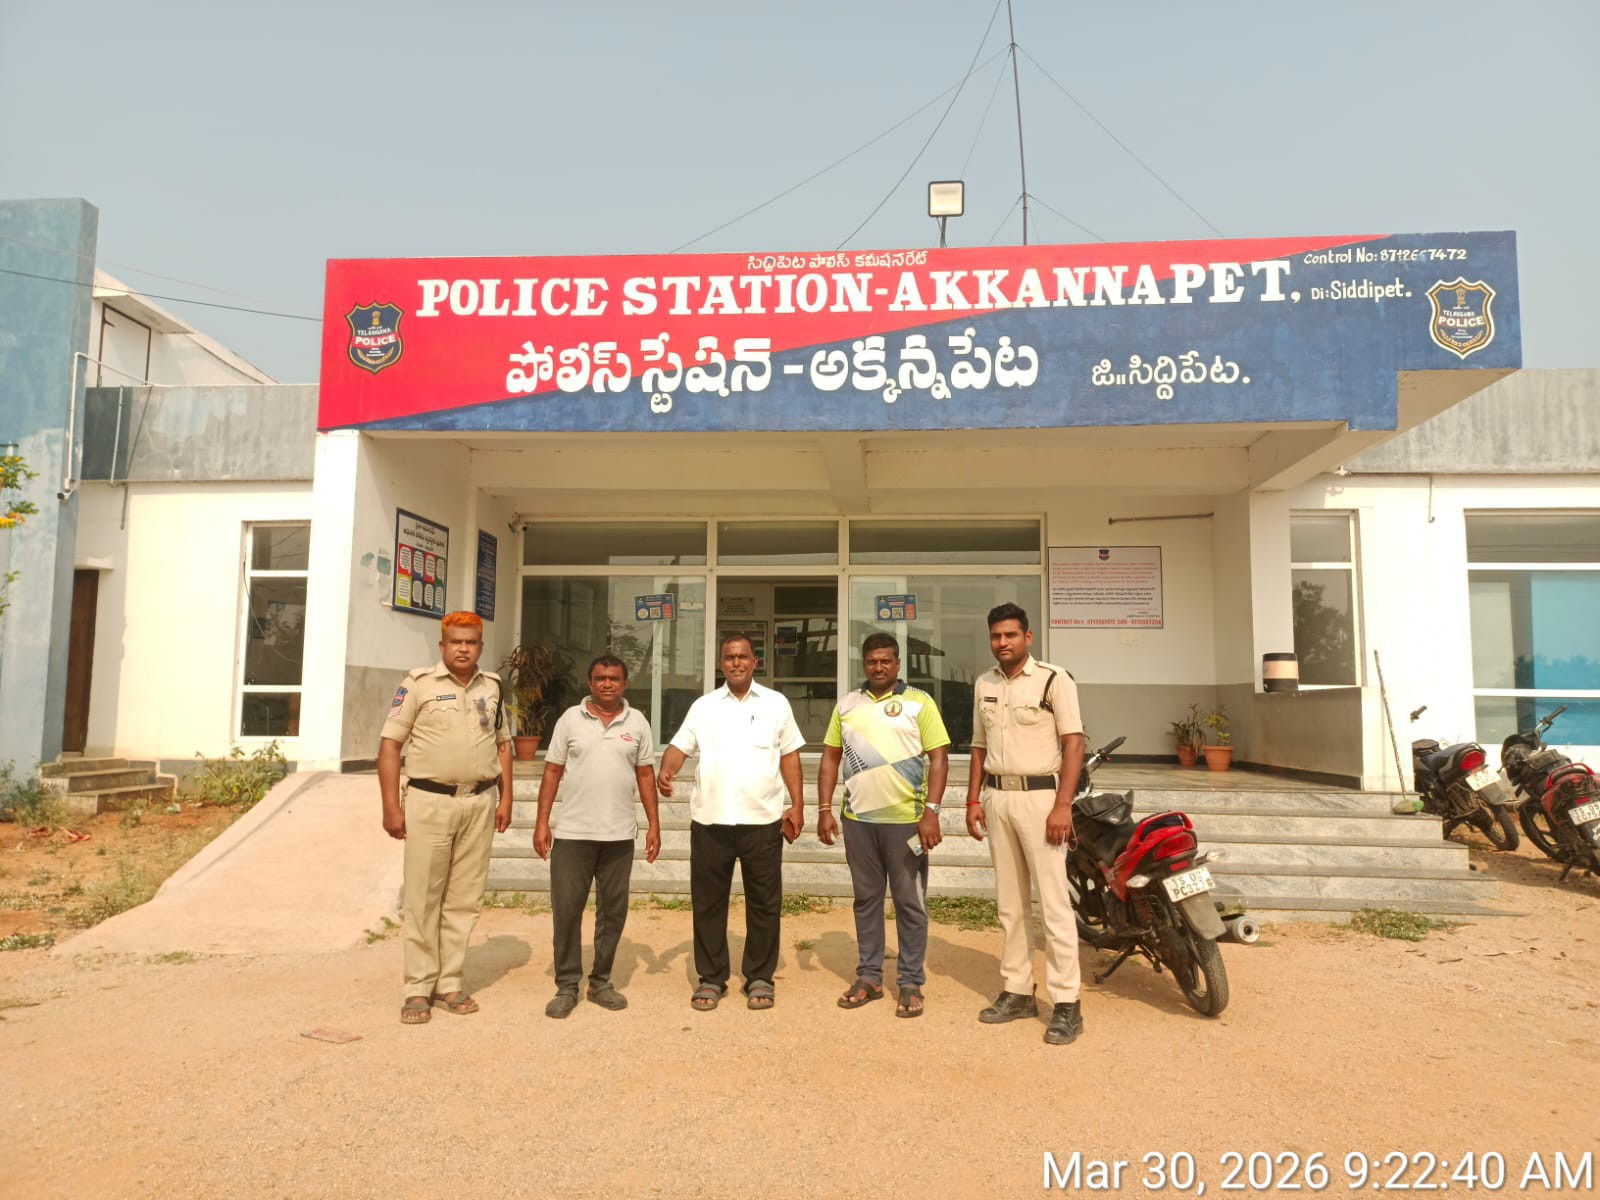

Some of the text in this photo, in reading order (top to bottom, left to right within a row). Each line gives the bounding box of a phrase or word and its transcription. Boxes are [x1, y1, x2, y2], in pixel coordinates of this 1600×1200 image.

[1303, 249, 1352, 265] Control
[415, 277, 609, 317] POLICE
[1438, 316, 1486, 328] POLICE
[355, 334, 397, 346] POLICE
